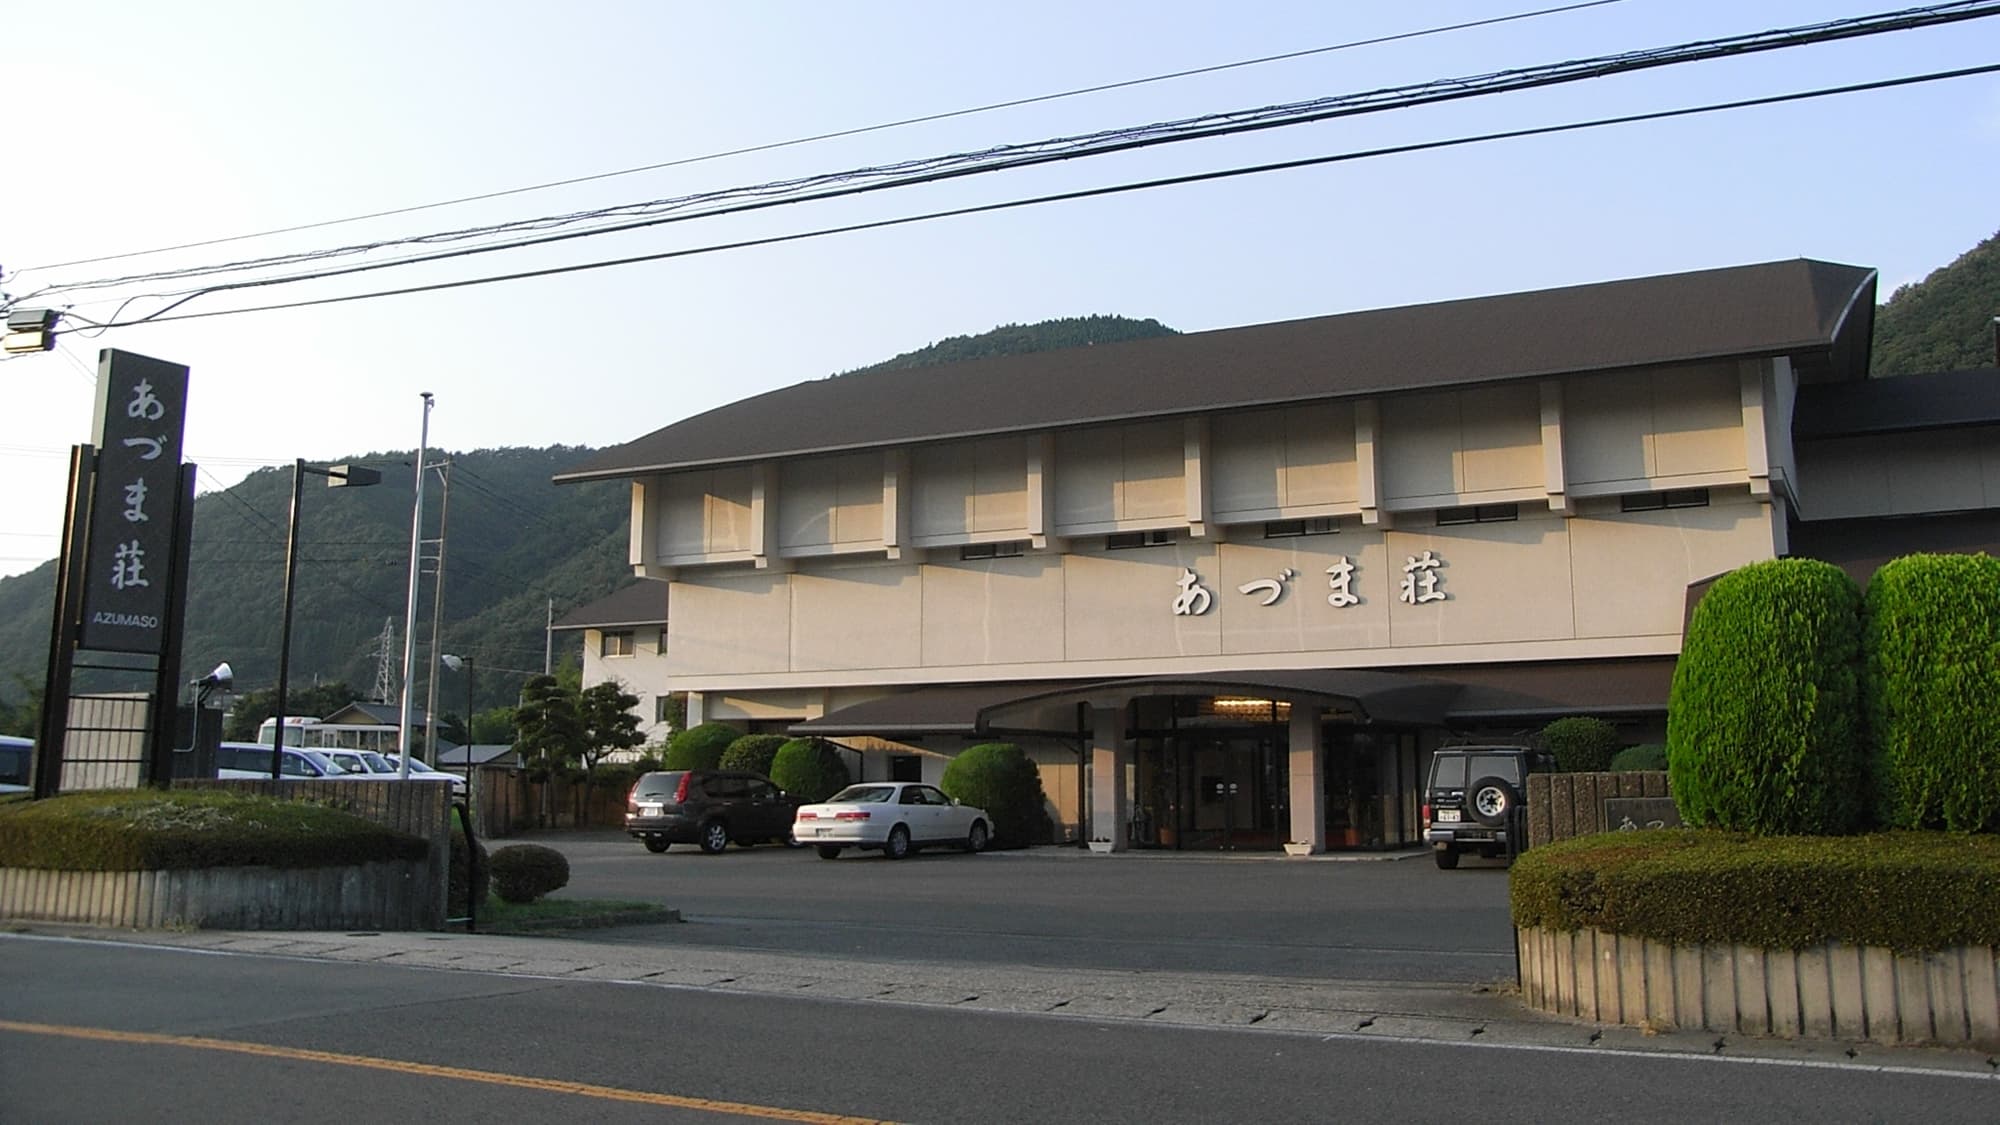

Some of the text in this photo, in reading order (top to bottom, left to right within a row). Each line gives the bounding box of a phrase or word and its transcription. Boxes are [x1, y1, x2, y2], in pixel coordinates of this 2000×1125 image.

[111, 378, 167, 590] あづま荘
[1172, 551, 1447, 616] あづま荘
[93, 611, 158, 629] AZUMASO
